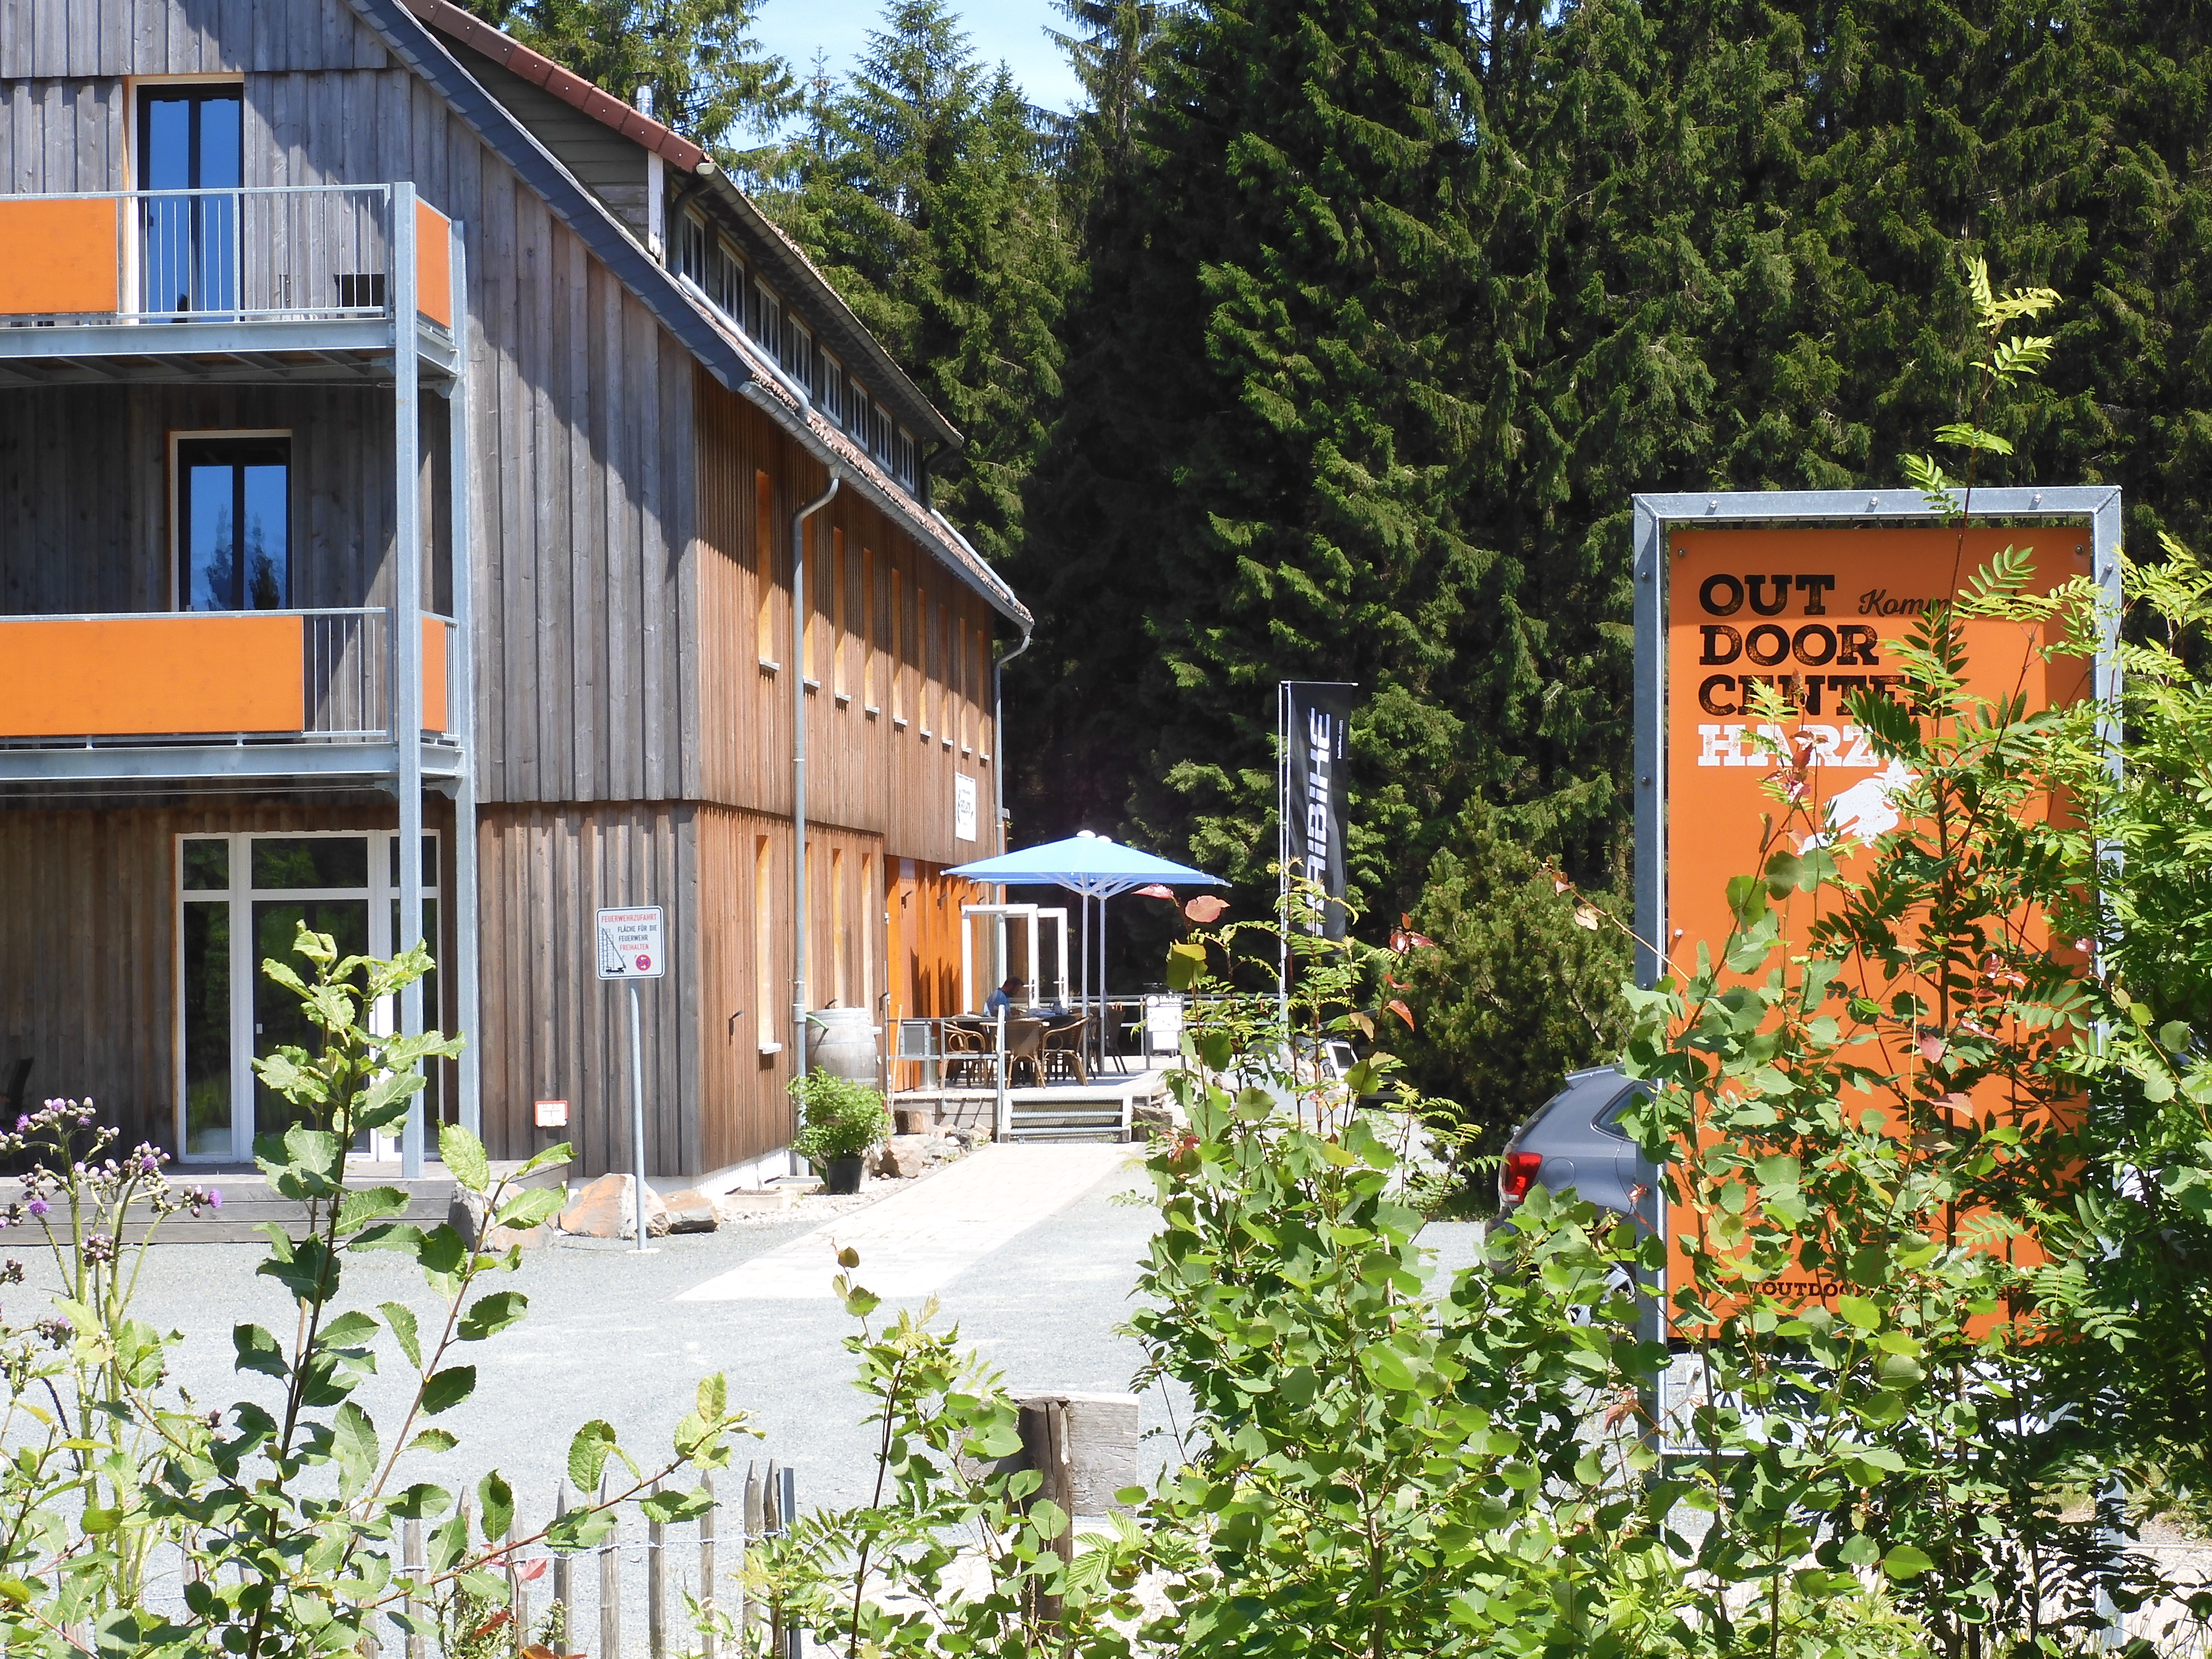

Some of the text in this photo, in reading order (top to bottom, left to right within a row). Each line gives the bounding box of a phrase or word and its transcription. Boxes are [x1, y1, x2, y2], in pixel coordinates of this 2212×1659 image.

[1699, 574, 1835, 616] OUT
[1699, 624, 1879, 666] DOOR
[1697, 724, 1879, 767] HARZ
[601, 914, 657, 923] FEUERWEHRZUFAHRT
[617, 925, 636, 933] FLÄCHE
